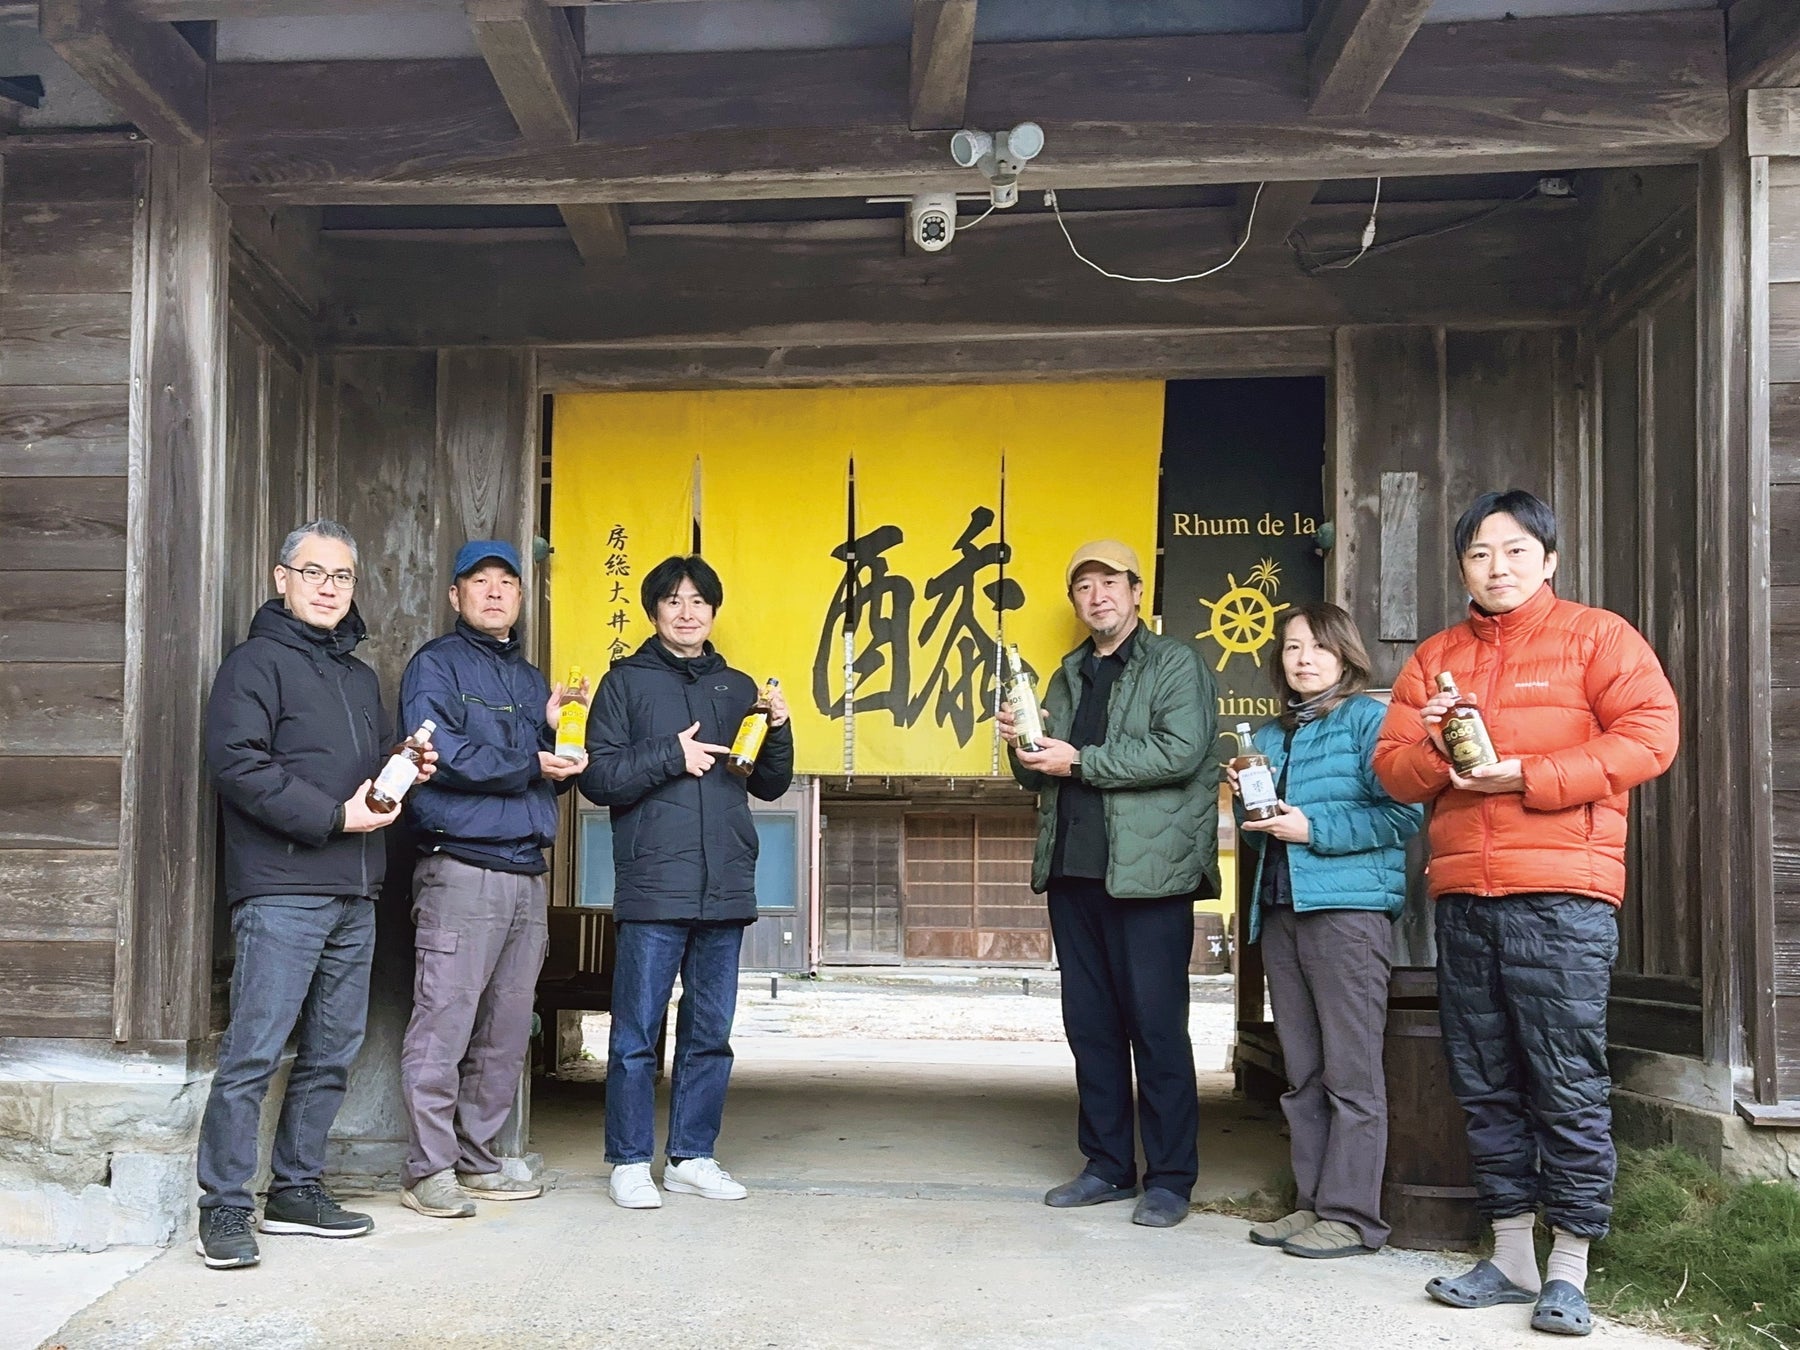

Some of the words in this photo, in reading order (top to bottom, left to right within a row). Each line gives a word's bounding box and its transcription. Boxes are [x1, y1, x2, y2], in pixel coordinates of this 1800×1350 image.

[1172, 512, 1249, 537] Rhum
[1257, 512, 1286, 536] de
[1293, 511, 1316, 535] la
[604, 524, 632, 662] 房総大井倉
[1444, 724, 1475, 742] BOSO
